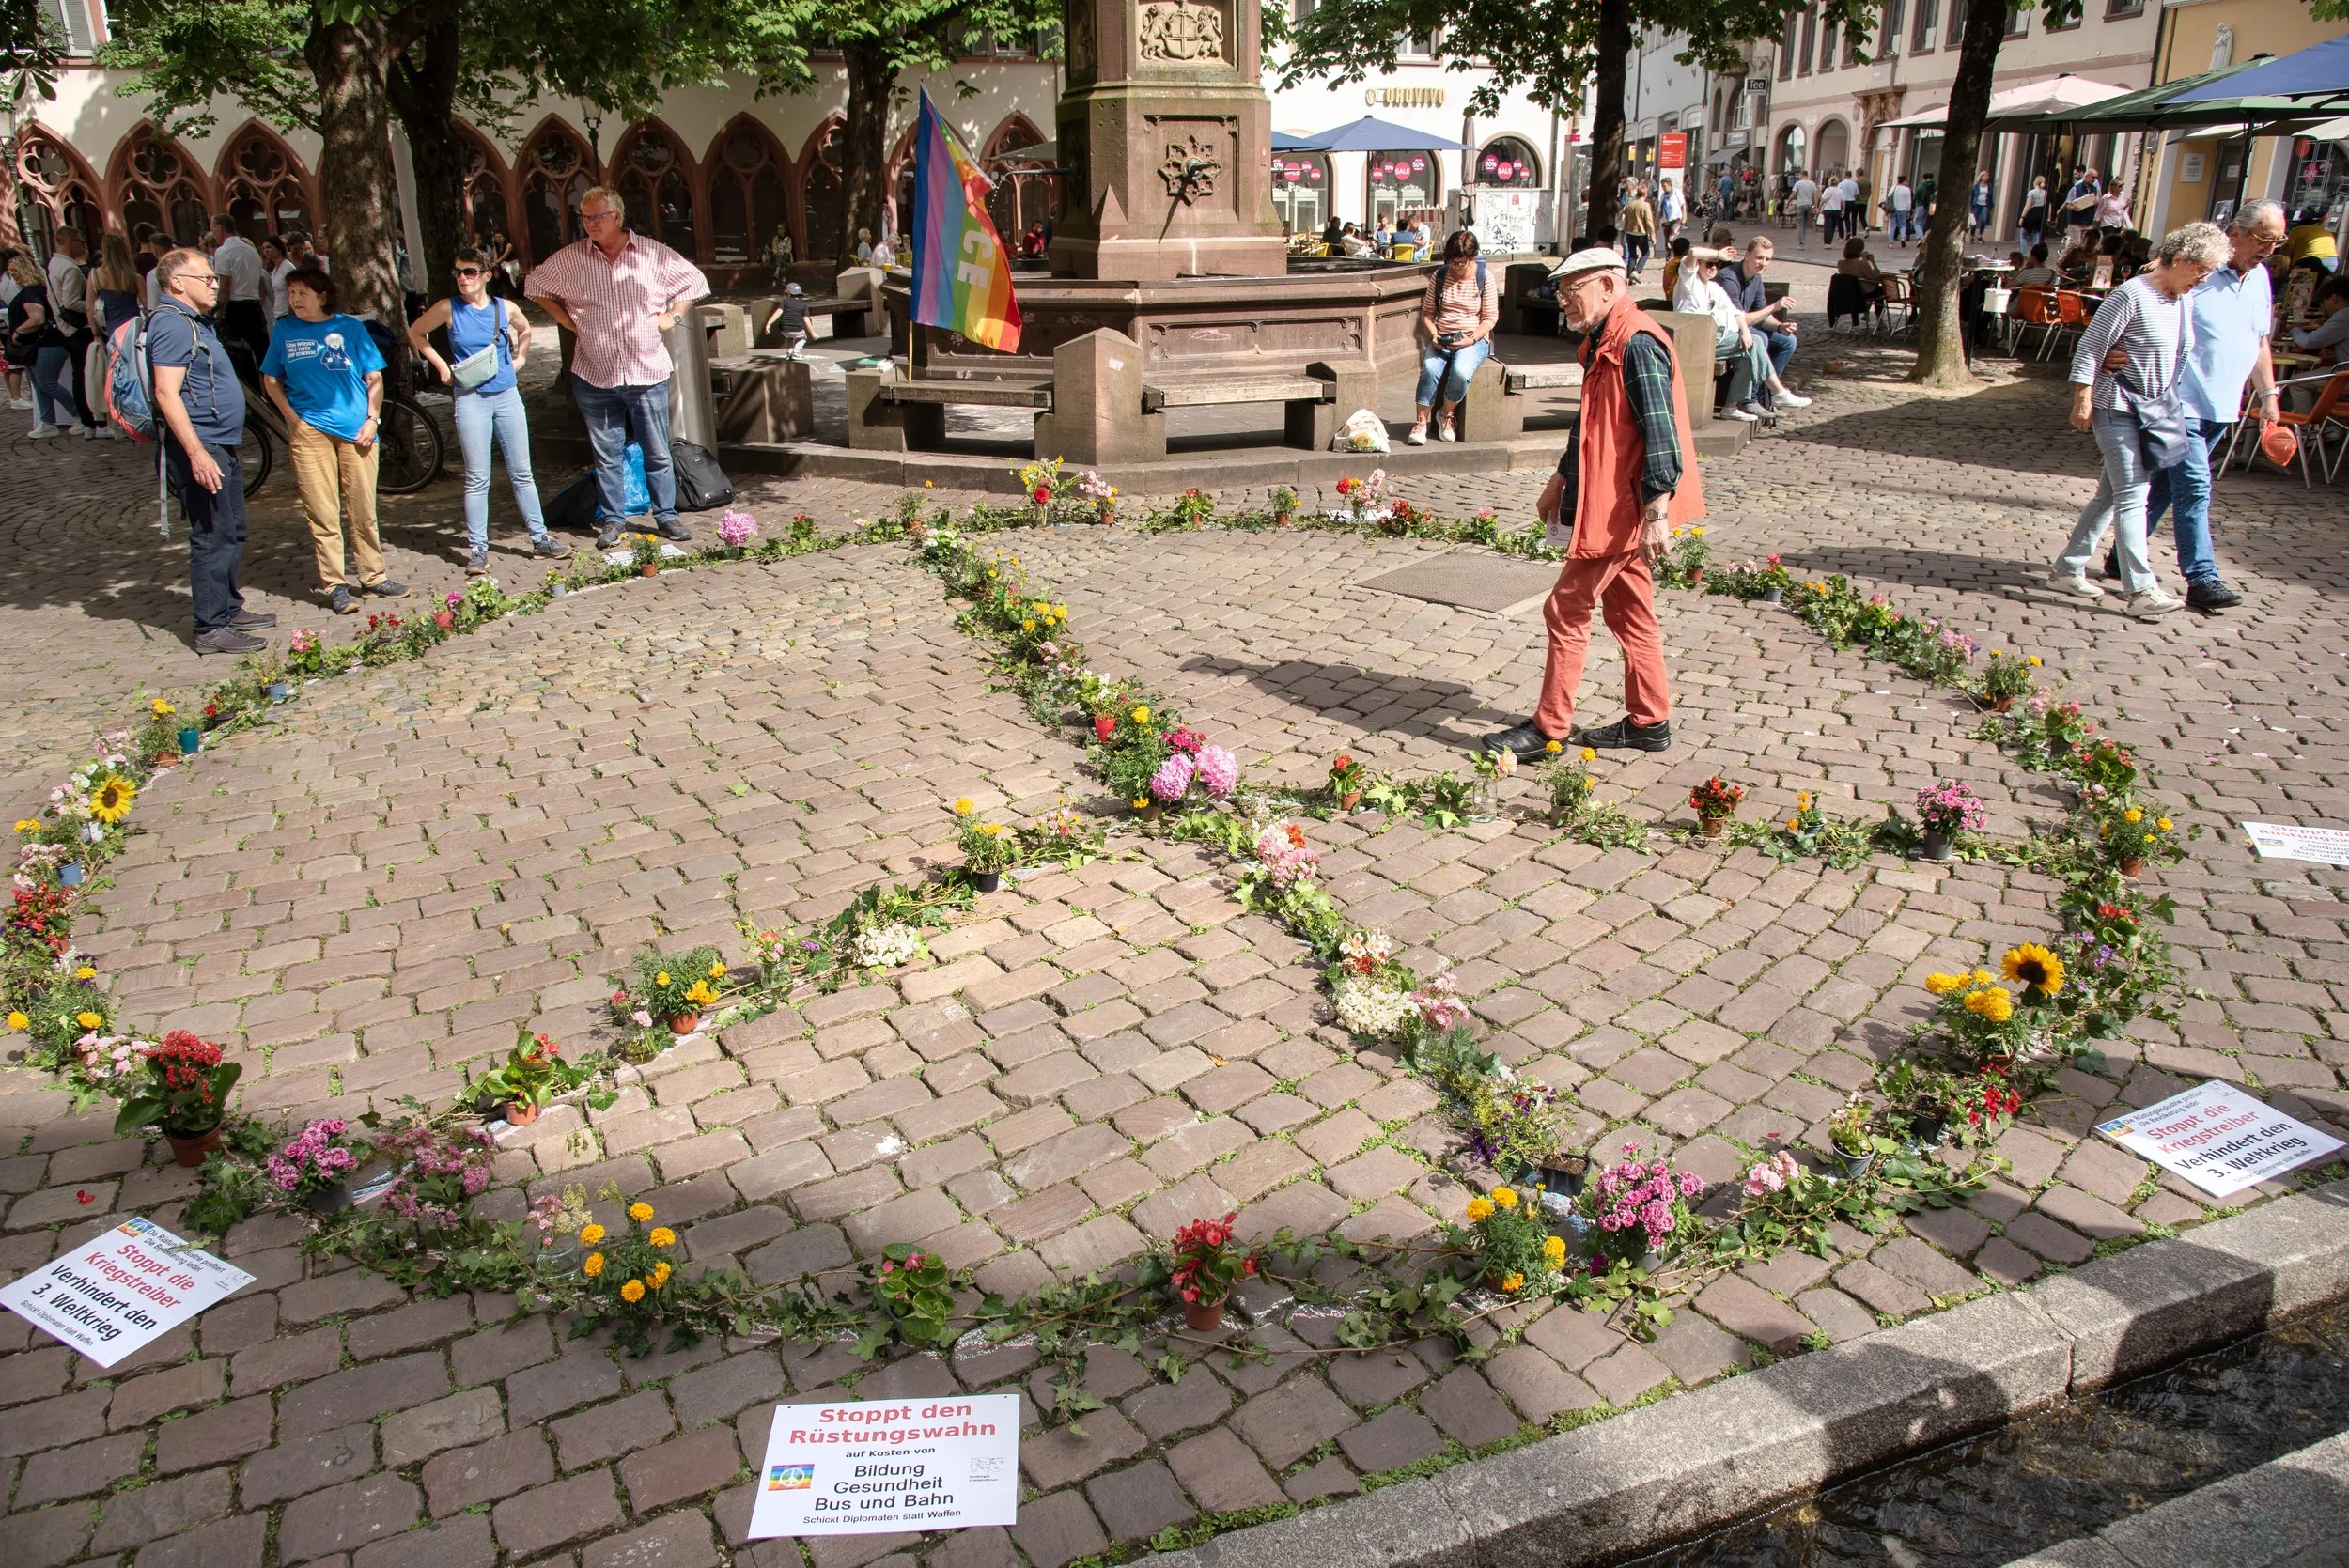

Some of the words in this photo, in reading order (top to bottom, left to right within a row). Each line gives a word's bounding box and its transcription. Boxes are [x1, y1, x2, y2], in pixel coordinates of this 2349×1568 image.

[1385, 86, 1445, 104] OROVIVO
[1749, 80, 1765, 89] Tee
[2271, 825, 2327, 835] Stoppt
[2133, 1100, 2183, 1121] Rüstungsindustrie
[2150, 1107, 2186, 1123] Bevölkerung
[2146, 1114, 2204, 1141] Stoppt
[2203, 1103, 2232, 1118] die
[2157, 1110, 2260, 1155] Kriegstreiber
[2174, 1133, 2263, 1170] Verhindert
[2260, 1122, 2293, 1138] den
[2206, 1168, 2231, 1178] 3.
[2225, 1136, 2308, 1172] Weltkrieg
[144, 1237, 157, 1247] Die
[147, 1229, 159, 1239] Die
[117, 1243, 171, 1277] Stoppt
[167, 1269, 195, 1291] die
[84, 1251, 182, 1309] Kriegstreiber
[51, 1264, 130, 1313] Verhindert
[123, 1308, 158, 1330] den
[31, 1283, 52, 1298] 3.
[49, 1293, 123, 1342] Weltkrieg
[37, 1310, 66, 1329] Diplomaten
[63, 1326, 79, 1336] statt
[74, 1332, 95, 1346] Waffen
[819, 1406, 911, 1425] Stoppt
[921, 1404, 972, 1419] den
[789, 1421, 996, 1445] Rüstungswahn
[868, 1449, 910, 1458] Kosten
[854, 1464, 925, 1478] Bildung
[833, 1476, 943, 1494] Gesundheit
[815, 1498, 851, 1511] Bus
[860, 1496, 895, 1509] und
[904, 1493, 954, 1507] Bahn
[802, 1515, 839, 1524] Schickt
[843, 1513, 899, 1524] Diplomaten
[902, 1512, 924, 1520] statt
[927, 1509, 961, 1518] Waffen
